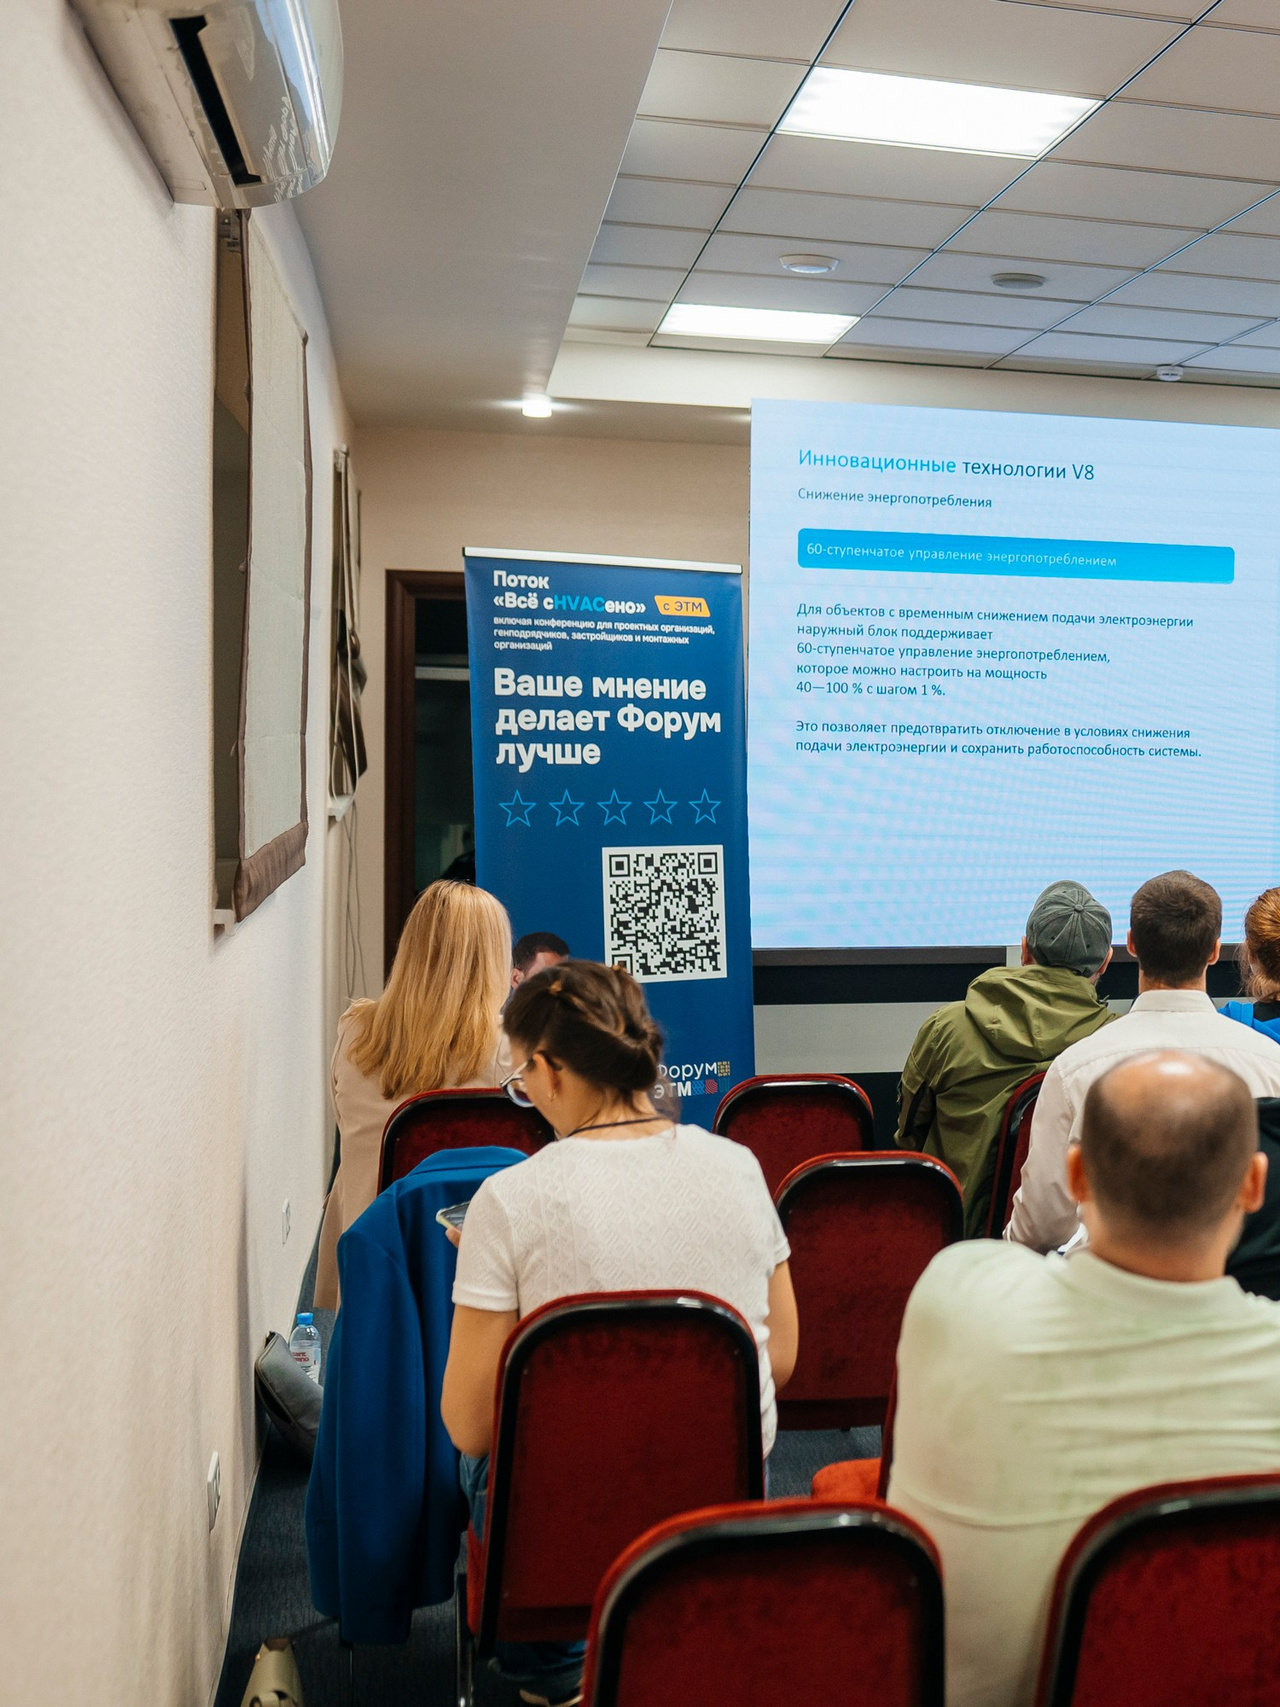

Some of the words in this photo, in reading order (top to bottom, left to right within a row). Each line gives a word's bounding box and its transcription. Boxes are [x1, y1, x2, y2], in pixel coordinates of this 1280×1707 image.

[799, 449, 956, 474] Инновационные
[963, 461, 1066, 479] технологии
[1072, 464, 1094, 480] V8
[798, 488, 864, 502] Снижение
[868, 493, 992, 508] энергопотребления
[807, 542, 904, 559] 60-ступенчатое
[909, 549, 982, 562] управление
[987, 552, 1116, 567] энергопотреблением
[494, 570, 549, 589] Поток
[494, 592, 537, 609] «Всё
[663, 602, 669, 610] с
[674, 600, 702, 612] ЭТМ
[797, 603, 822, 617] Для
[826, 605, 885, 618] объектов
[889, 609, 895, 617] с
[899, 608, 973, 621] временным
[977, 611, 1048, 622] снижением
[1052, 613, 1095, 626] подачи
[1099, 614, 1193, 628] электроэнергии
[494, 617, 532, 625] включая
[534, 618, 595, 629] конференцию
[597, 621, 612, 629] для
[614, 621, 658, 631] проектных
[661, 623, 715, 634] организаций,
[797, 624, 864, 638] наружный
[868, 625, 897, 637] блок
[901, 627, 993, 642] поддерживает
[494, 629, 569, 640] генподрядчиков,
[572, 632, 633, 642] застройщиков
[635, 634, 641, 642] и
[643, 635, 689, 644] монтажных
[494, 641, 552, 650] организаций
[797, 643, 894, 659] 60-ступенчатое
[898, 647, 972, 659] управление
[976, 650, 1110, 664] энергопотреблением,
[797, 663, 849, 677] которое
[852, 665, 896, 676] можно
[900, 668, 963, 679] настроить
[967, 669, 981, 677] на
[985, 670, 1047, 680] мощность
[494, 668, 583, 697] Ваше
[593, 677, 706, 700] мнение
[852, 683, 862, 695] %
[867, 686, 873, 695] с
[877, 685, 917, 697] шагом
[921, 685, 927, 695] 1
[931, 685, 945, 695] %.
[496, 708, 610, 735] делает
[617, 704, 721, 740] Форум
[796, 721, 818, 732] Это
[822, 723, 886, 734] позволяет
[890, 724, 982, 737] предотвратить
[986, 726, 1060, 737] отключение
[1064, 728, 1070, 736] в
[1074, 728, 1128, 739] условиях
[1132, 730, 1190, 739] снижения
[496, 743, 601, 773] лучше
[796, 740, 842, 754] подачи
[846, 742, 946, 755] электроэнергии
[961, 745, 1024, 756] сохранить
[1027, 746, 1144, 758] работоспособность
[1149, 748, 1201, 757] системы.
